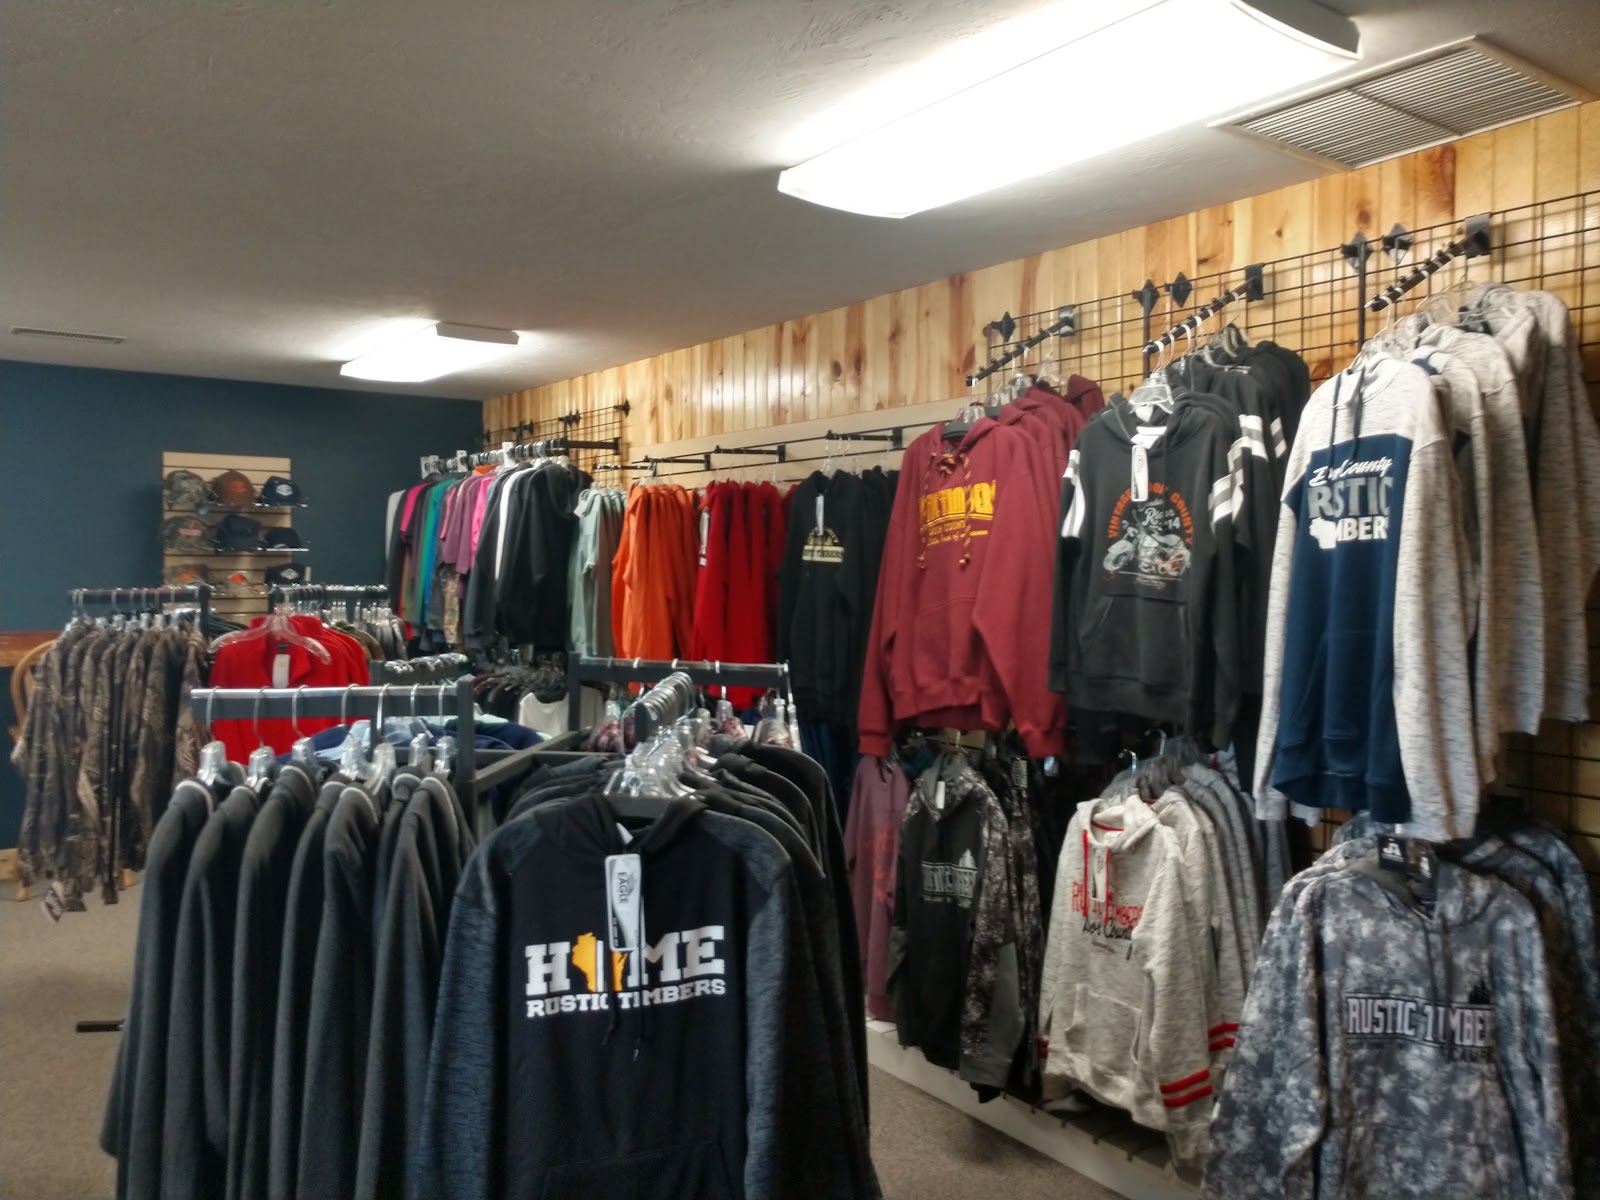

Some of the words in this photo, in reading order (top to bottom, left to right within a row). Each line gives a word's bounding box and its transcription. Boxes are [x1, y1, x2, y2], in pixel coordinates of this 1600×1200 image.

[617, 871, 629, 904] EAGLE
[617, 978, 727, 1010] TIMBERS
[1346, 997, 1417, 1037] RUSTIC
